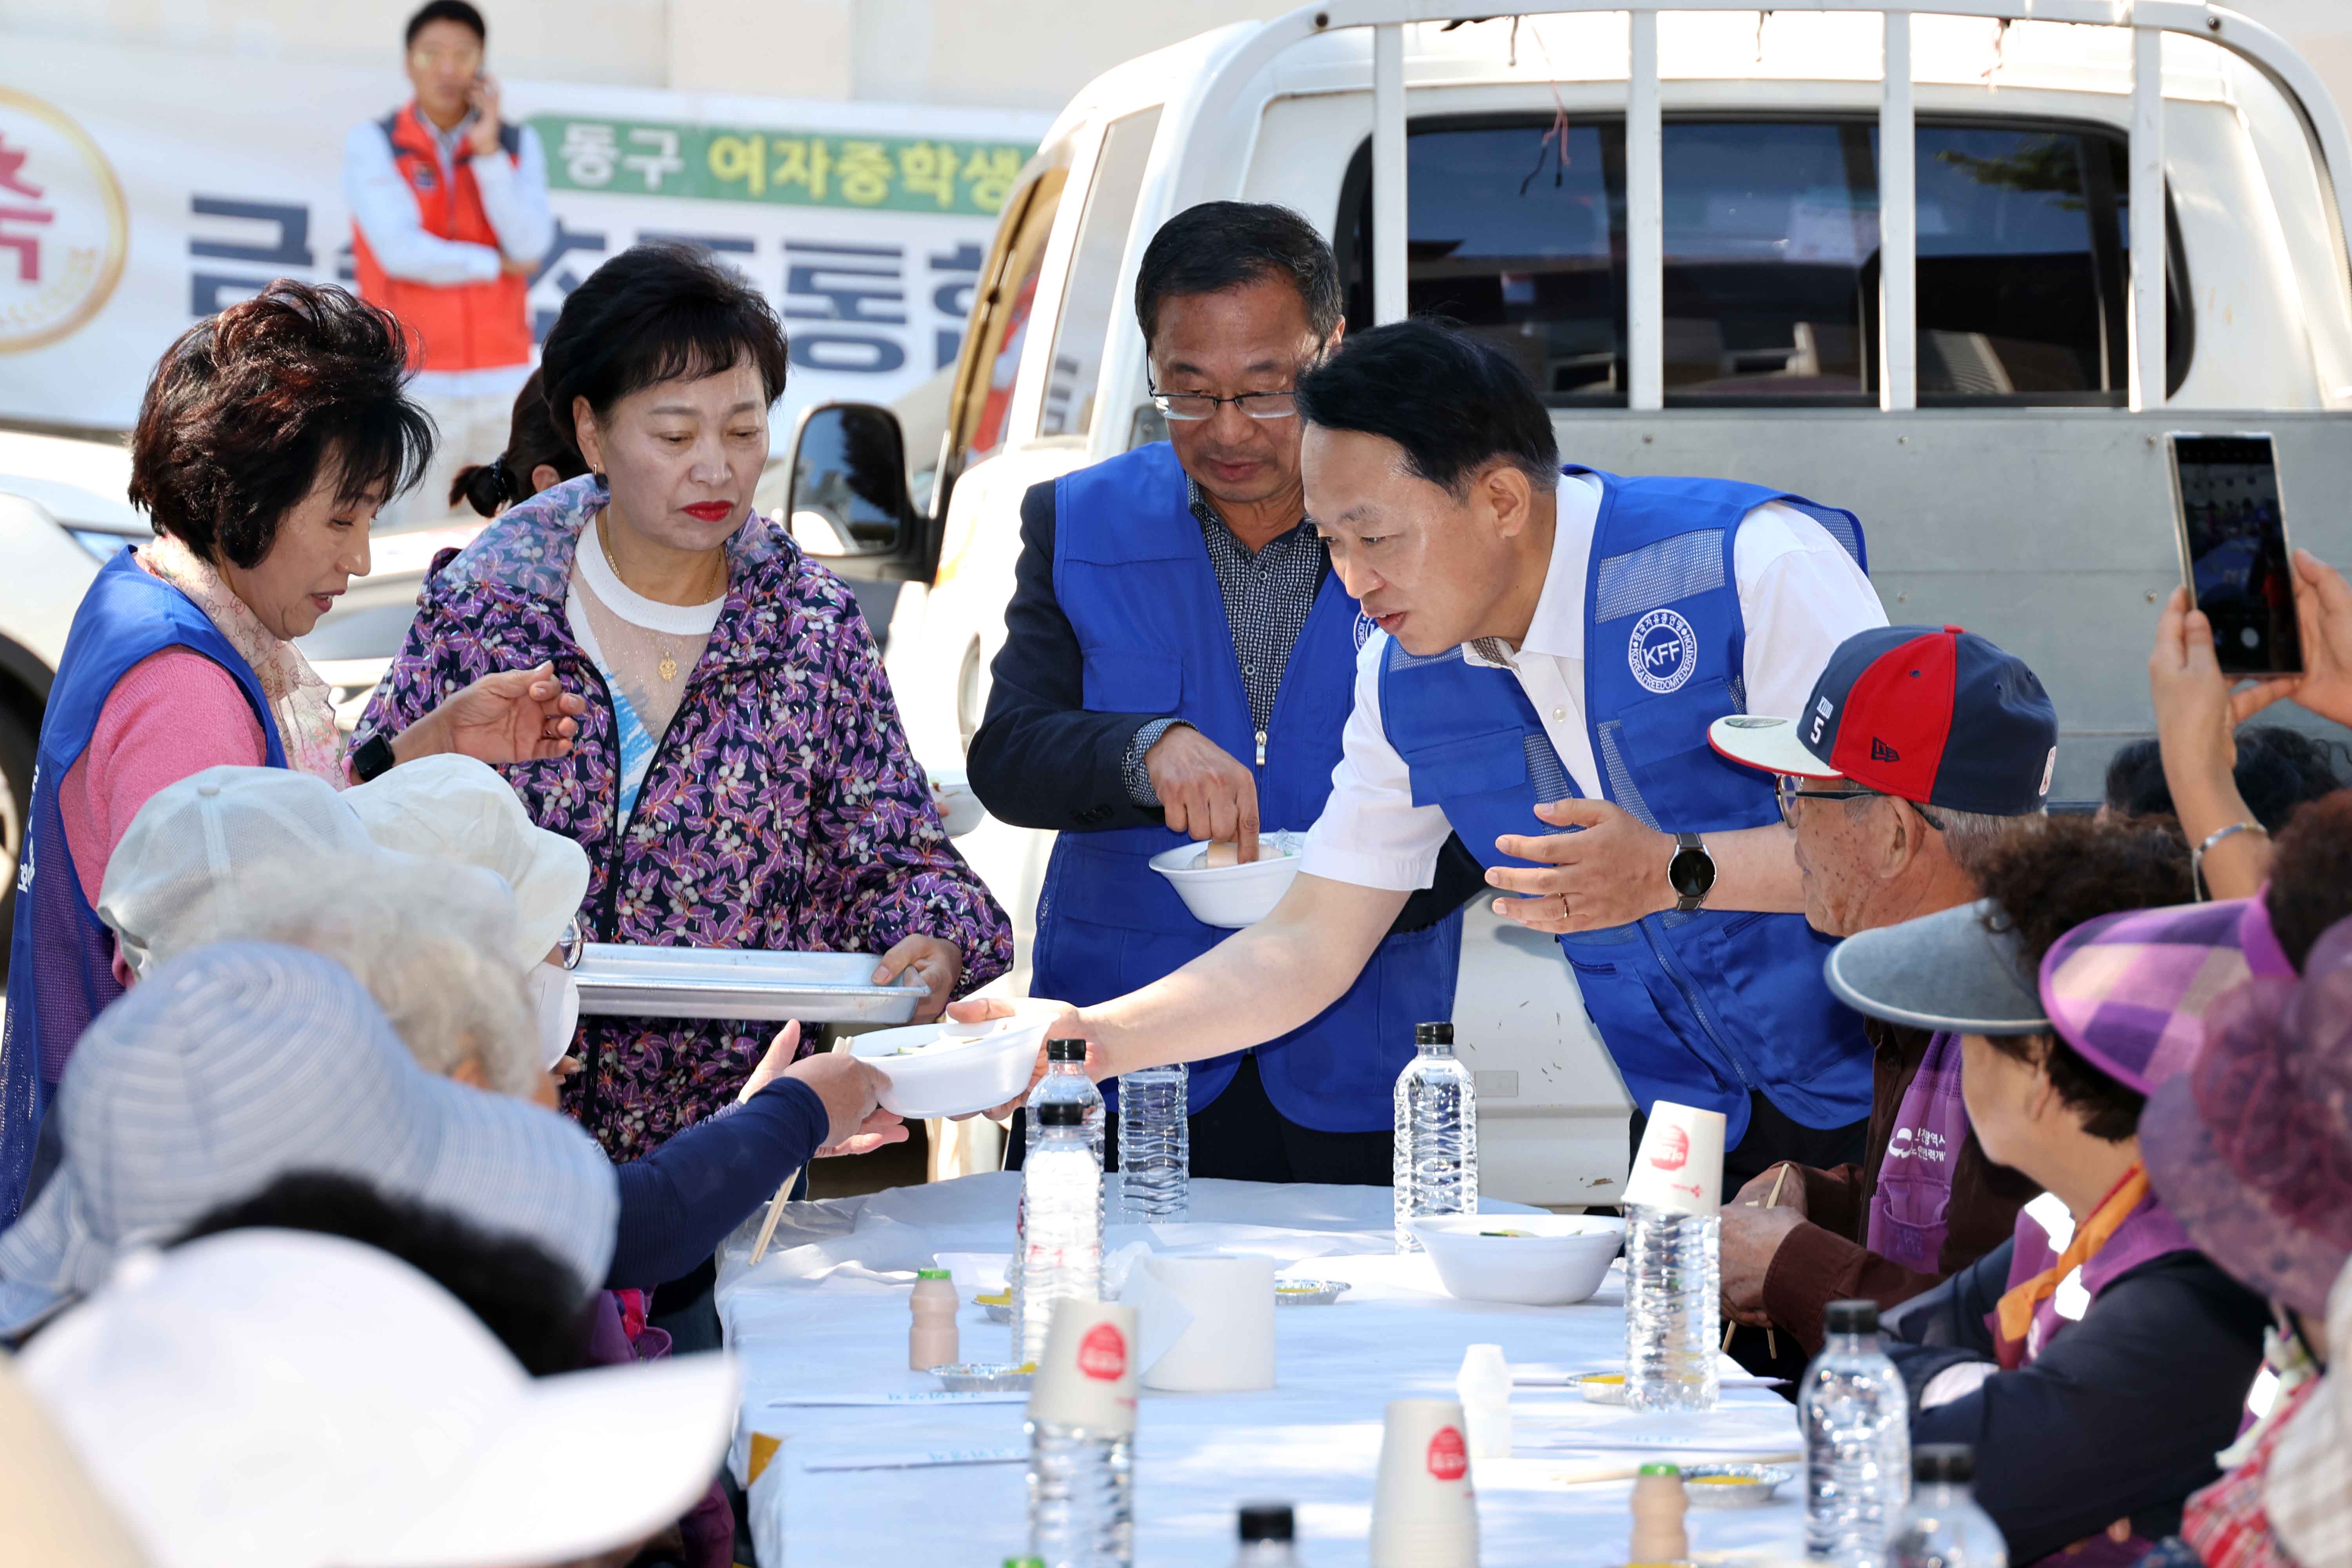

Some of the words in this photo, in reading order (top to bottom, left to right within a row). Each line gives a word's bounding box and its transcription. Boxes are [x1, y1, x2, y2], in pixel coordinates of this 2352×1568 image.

[558, 122, 686, 191] 동구
[1633, 613, 1684, 641] 한국자유총연맹
[1642, 639, 1681, 668] KFF
[1810, 715, 1825, 745] 5
